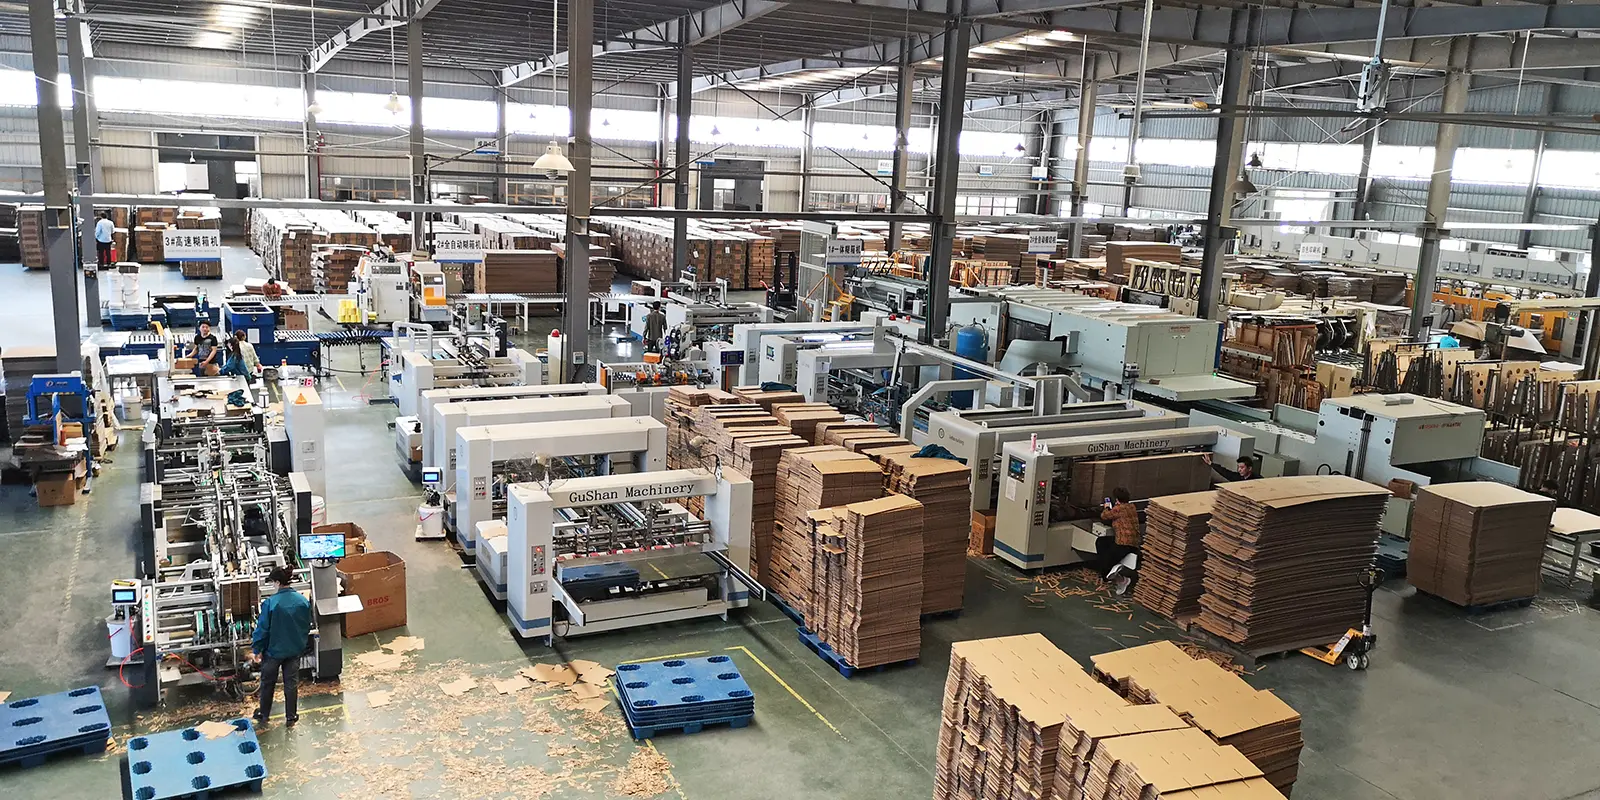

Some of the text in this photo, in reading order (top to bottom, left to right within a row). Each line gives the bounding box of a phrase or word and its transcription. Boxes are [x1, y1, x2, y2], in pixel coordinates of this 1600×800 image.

[165, 235, 218, 247] 3#高速糊箱机
[437, 239, 482, 249] 2#全自动糊箱机
[1087, 439, 1170, 453] GuShan Machinery
[569, 484, 694, 503] GuShan Machinery
[367, 595, 389, 606] BROS
